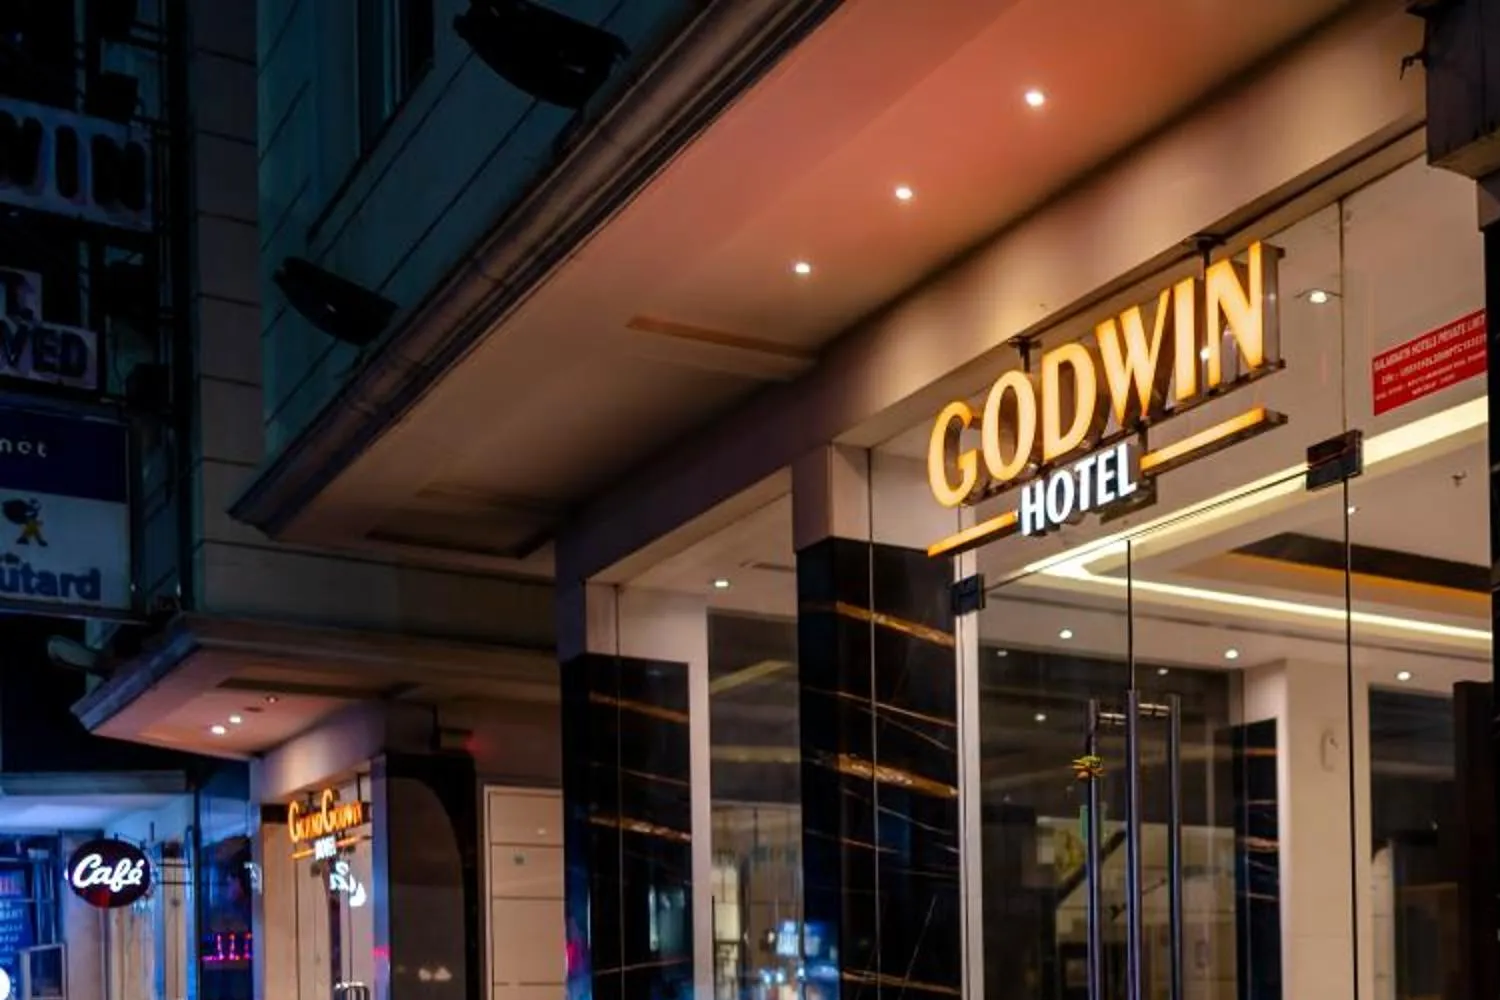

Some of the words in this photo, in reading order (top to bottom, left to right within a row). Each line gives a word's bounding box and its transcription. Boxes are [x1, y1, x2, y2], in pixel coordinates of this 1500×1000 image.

[928, 240, 1266, 508] GODWIN
[1019, 441, 1137, 536] HOTEL
[73, 853, 145, 892] Café
